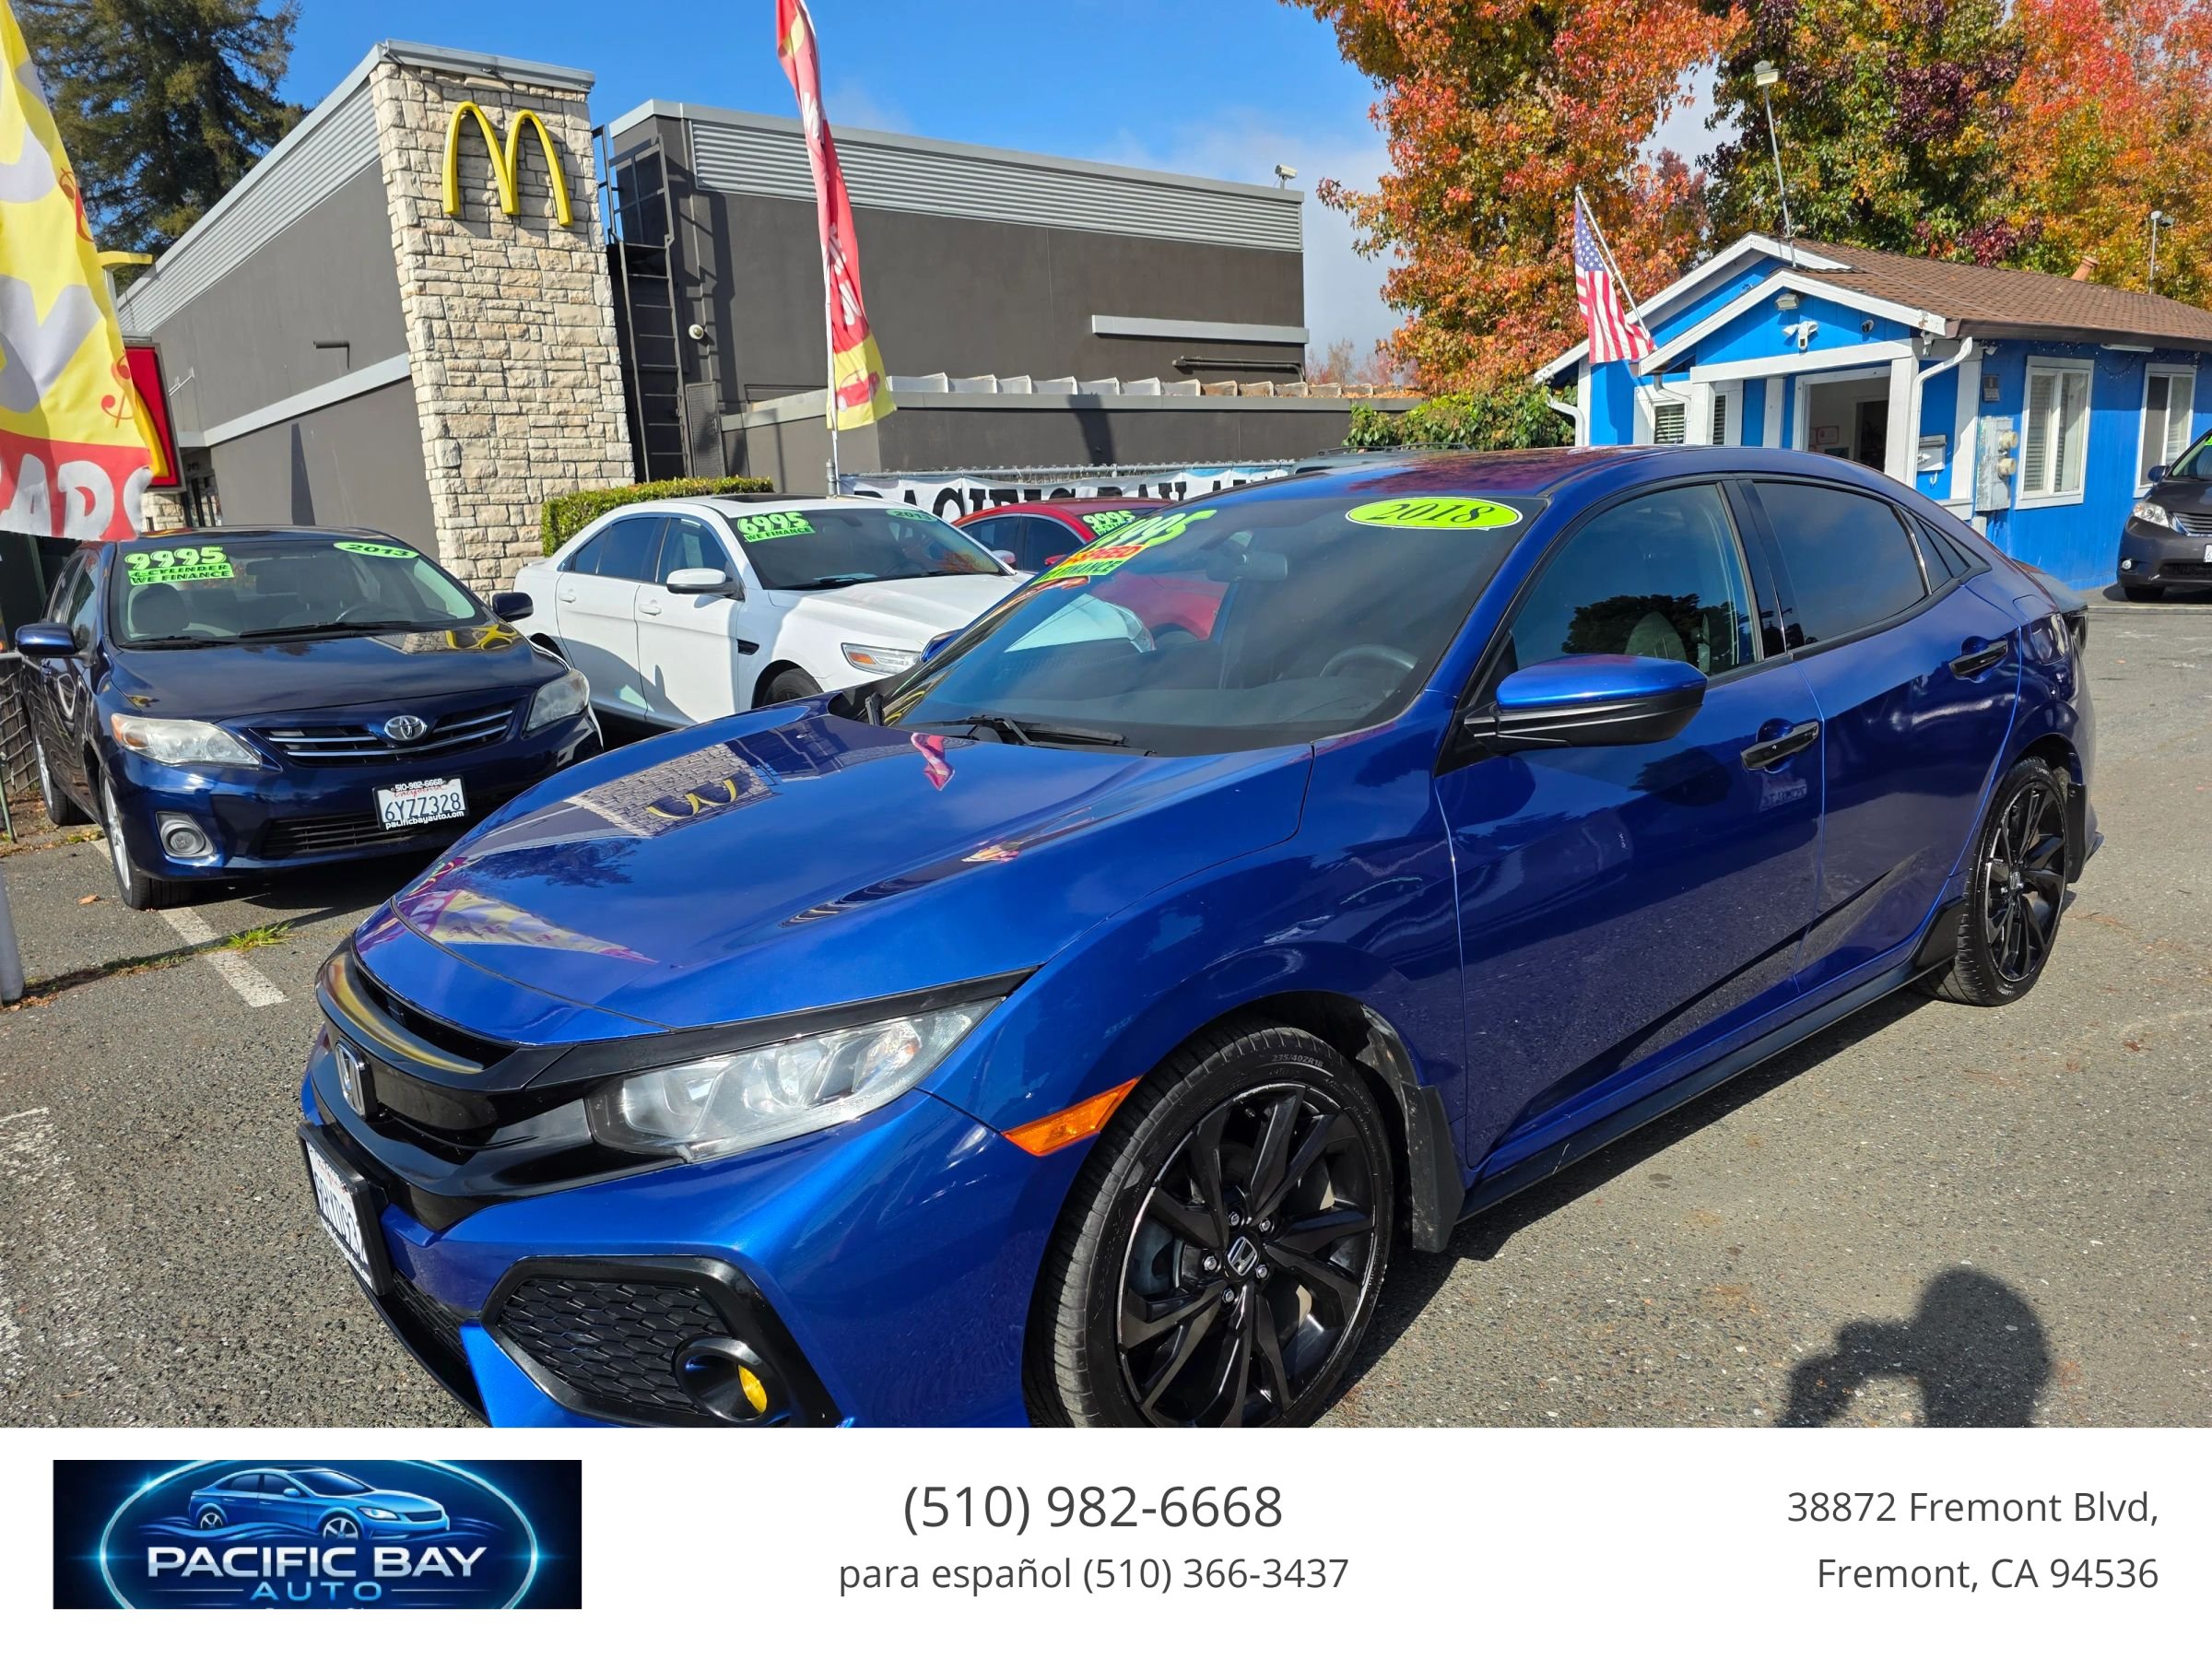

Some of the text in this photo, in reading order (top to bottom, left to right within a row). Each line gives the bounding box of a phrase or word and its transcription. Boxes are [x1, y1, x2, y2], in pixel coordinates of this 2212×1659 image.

[736, 512, 809, 535] 6995
[1366, 503, 1495, 524] 2018
[746, 526, 812, 541] WE FINANCE
[124, 546, 227, 570] 9995
[345, 544, 408, 557] 2013
[132, 570, 230, 584] WE FINANCE
[384, 792, 461, 822] 6YZZ328
[385, 810, 465, 830] pacificbayauto.com
